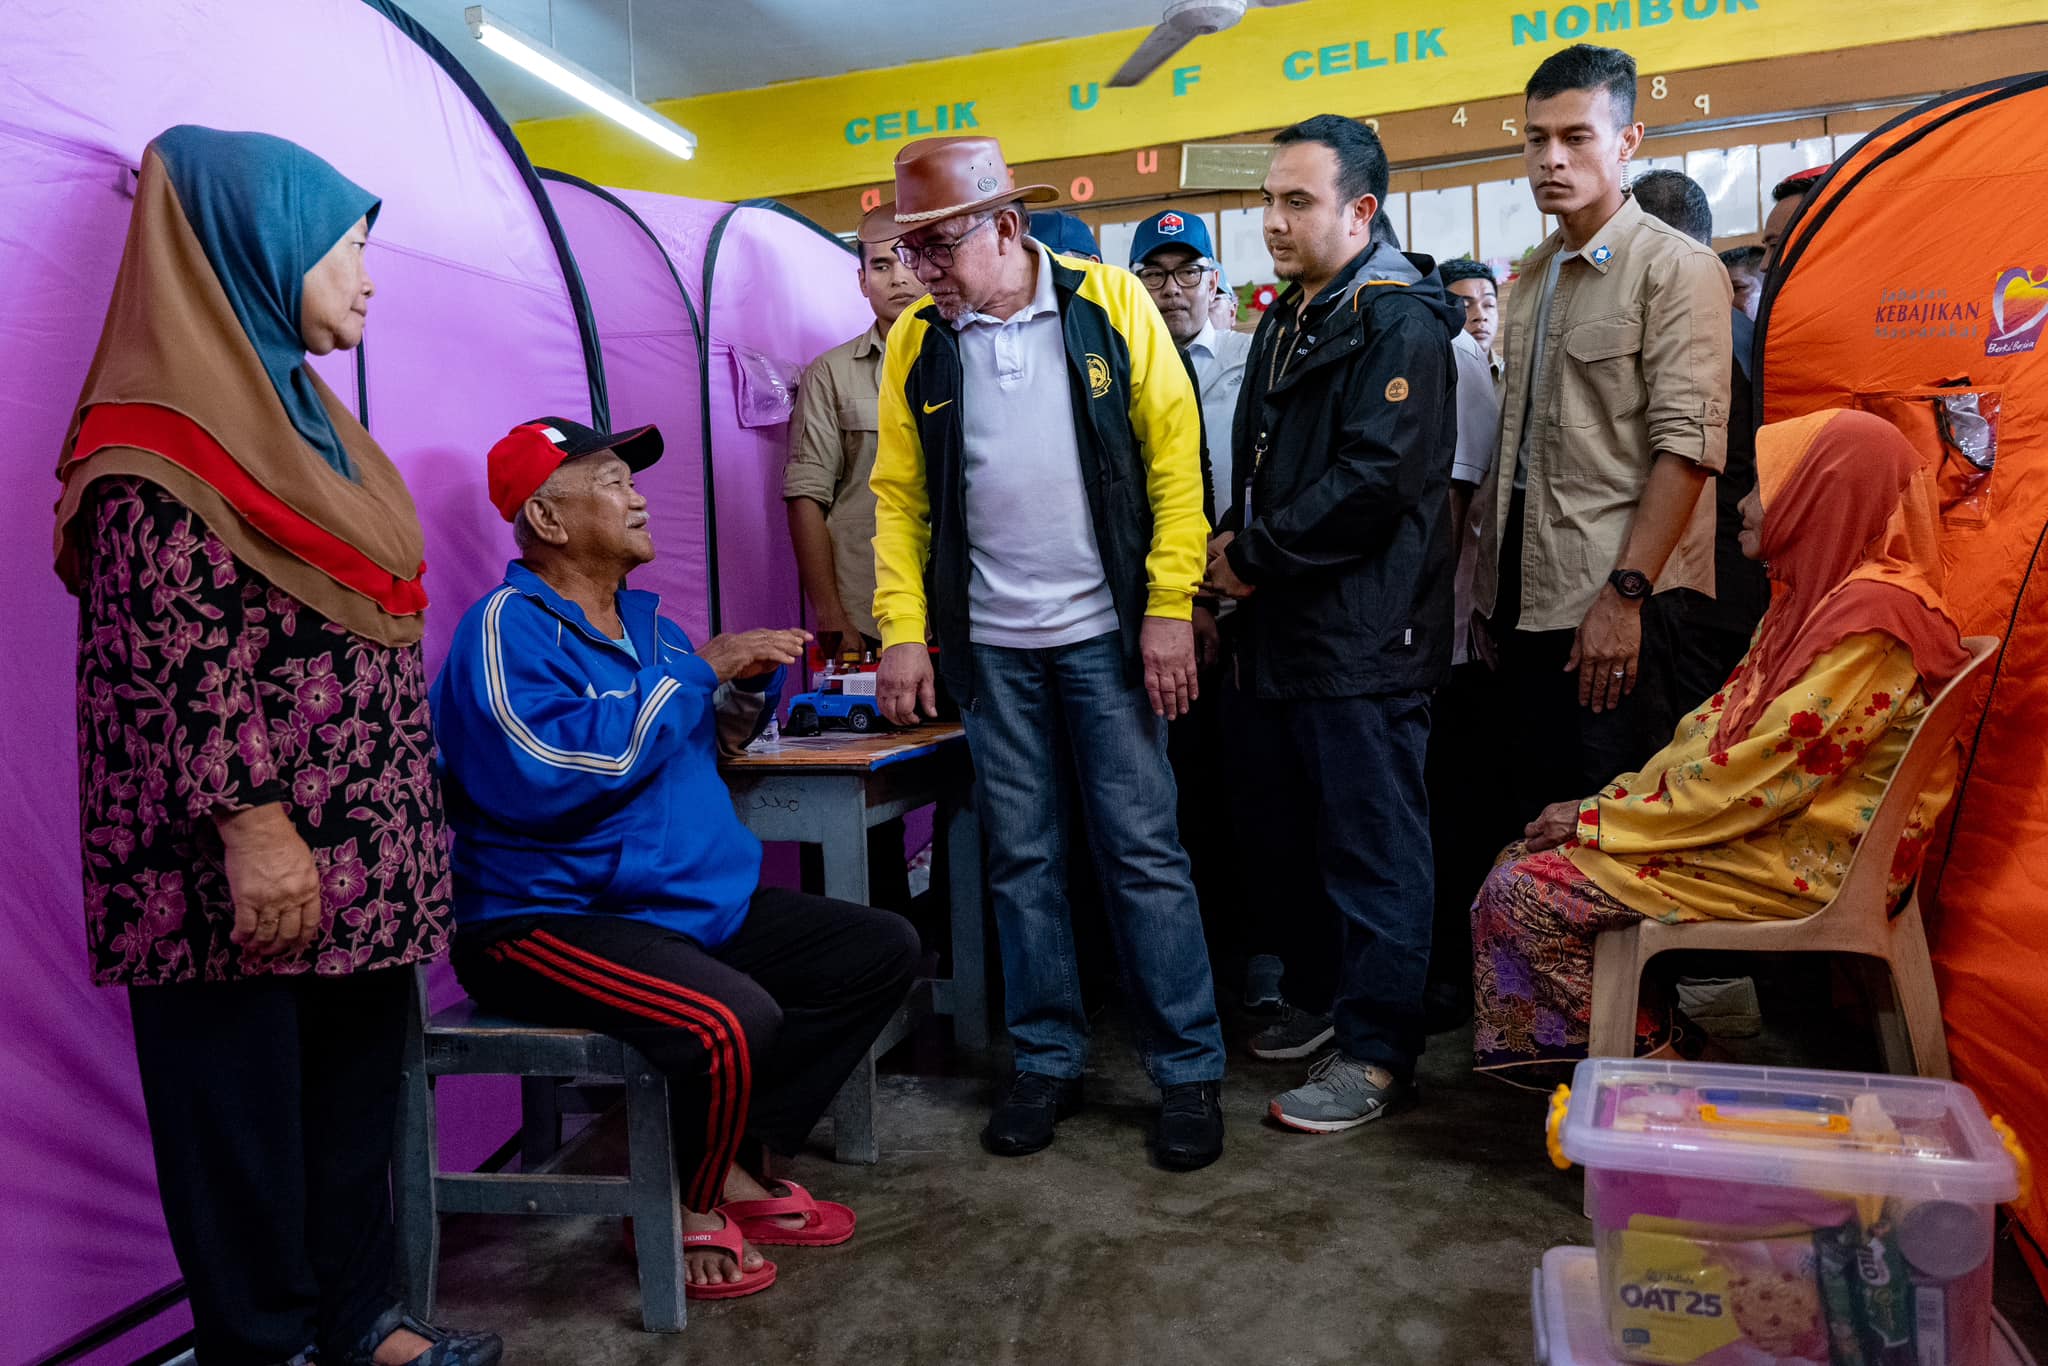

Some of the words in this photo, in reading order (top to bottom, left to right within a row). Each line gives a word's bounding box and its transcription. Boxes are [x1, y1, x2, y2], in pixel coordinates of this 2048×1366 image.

[1282, 27, 1449, 82] CELIK
[843, 101, 979, 146] CELIK
[1069, 82, 1100, 111] U
[1173, 64, 1202, 97] F
[1451, 106, 1469, 128] 4
[1501, 118, 1518, 137] 5
[1650, 75, 1668, 100] 8
[1875, 301, 1981, 325] KEBAJIKAN
[1619, 1284, 1682, 1312] OAT
[1685, 1291, 1723, 1318] 25
